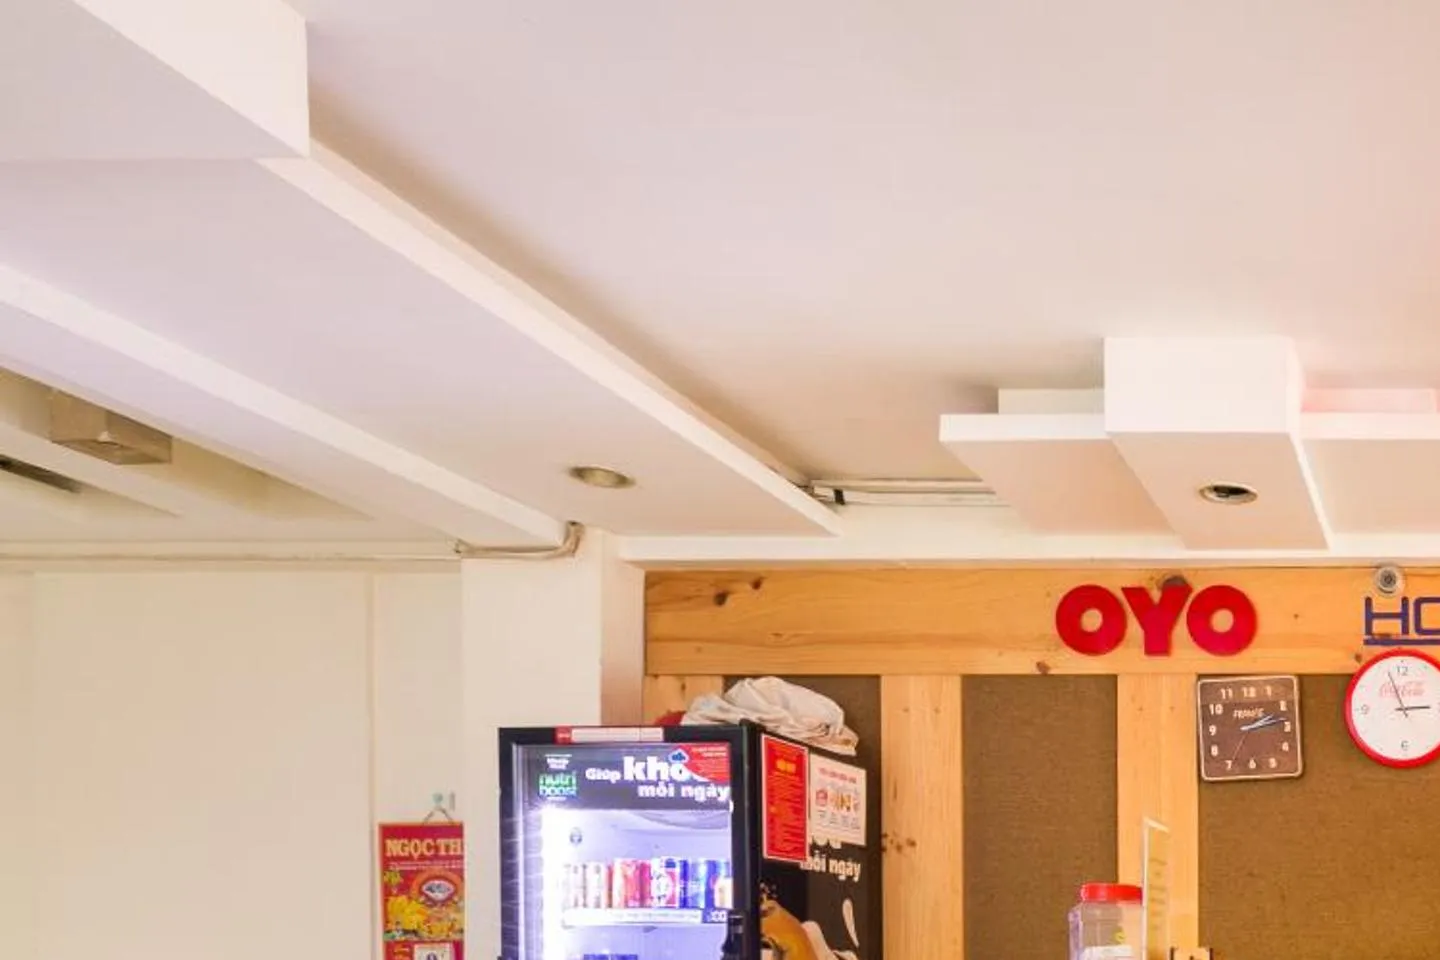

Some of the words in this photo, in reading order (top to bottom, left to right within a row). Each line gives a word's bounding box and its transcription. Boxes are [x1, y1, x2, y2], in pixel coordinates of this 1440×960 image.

[1056, 584, 1258, 656] OYO
[1220, 687, 1233, 699] 11
[1209, 703, 1223, 715] 10
[1209, 725, 1216, 736] 9
[1249, 758, 1256, 769] 6
[385, 838, 435, 860] NGỌC
